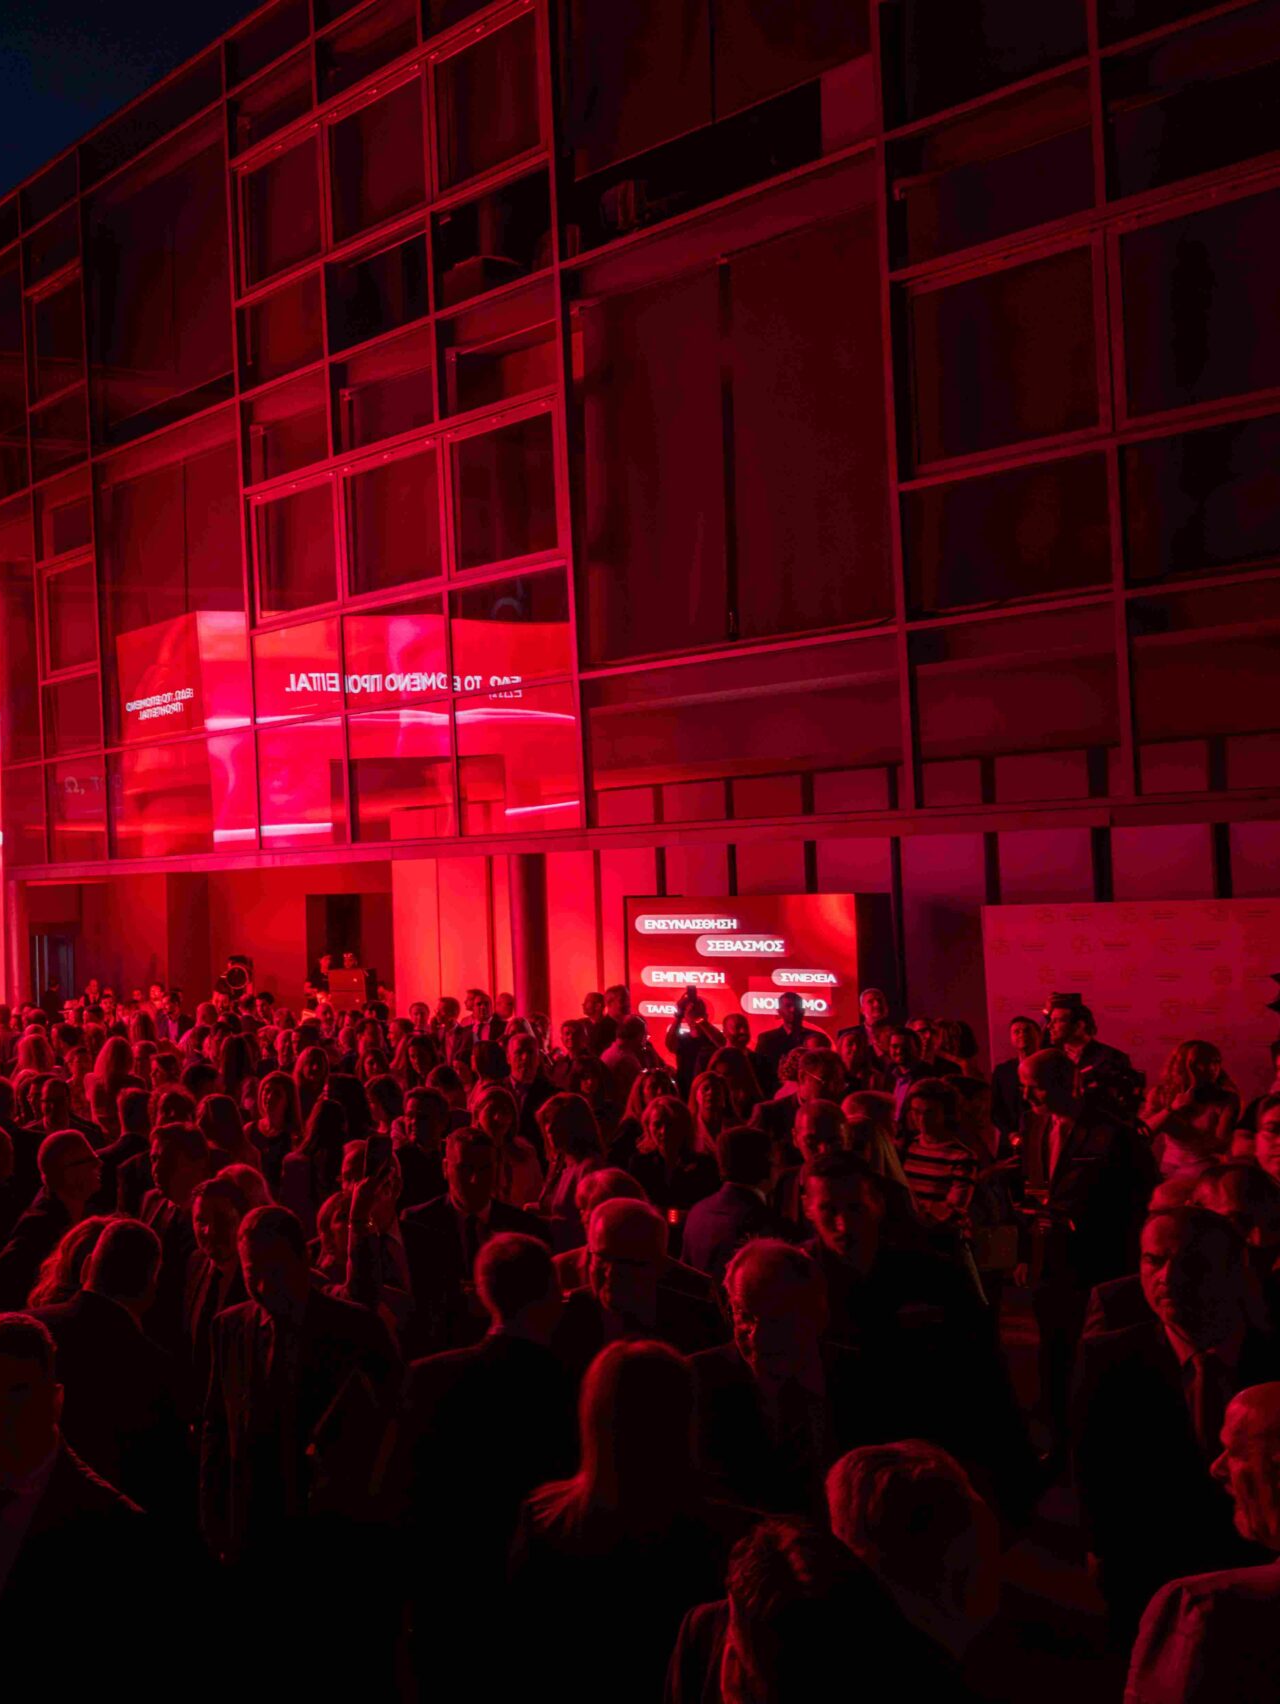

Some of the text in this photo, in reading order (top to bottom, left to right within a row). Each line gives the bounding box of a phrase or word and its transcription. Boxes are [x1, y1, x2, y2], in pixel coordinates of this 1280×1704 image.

[644, 918, 738, 930] ΕΝΣΥΝΑΙΣΘΗΣΗ
[706, 940, 785, 952] ΣΕΒΑΣΜΟΣ
[651, 971, 726, 984] ΕΜΠΝΕΥΣΗ
